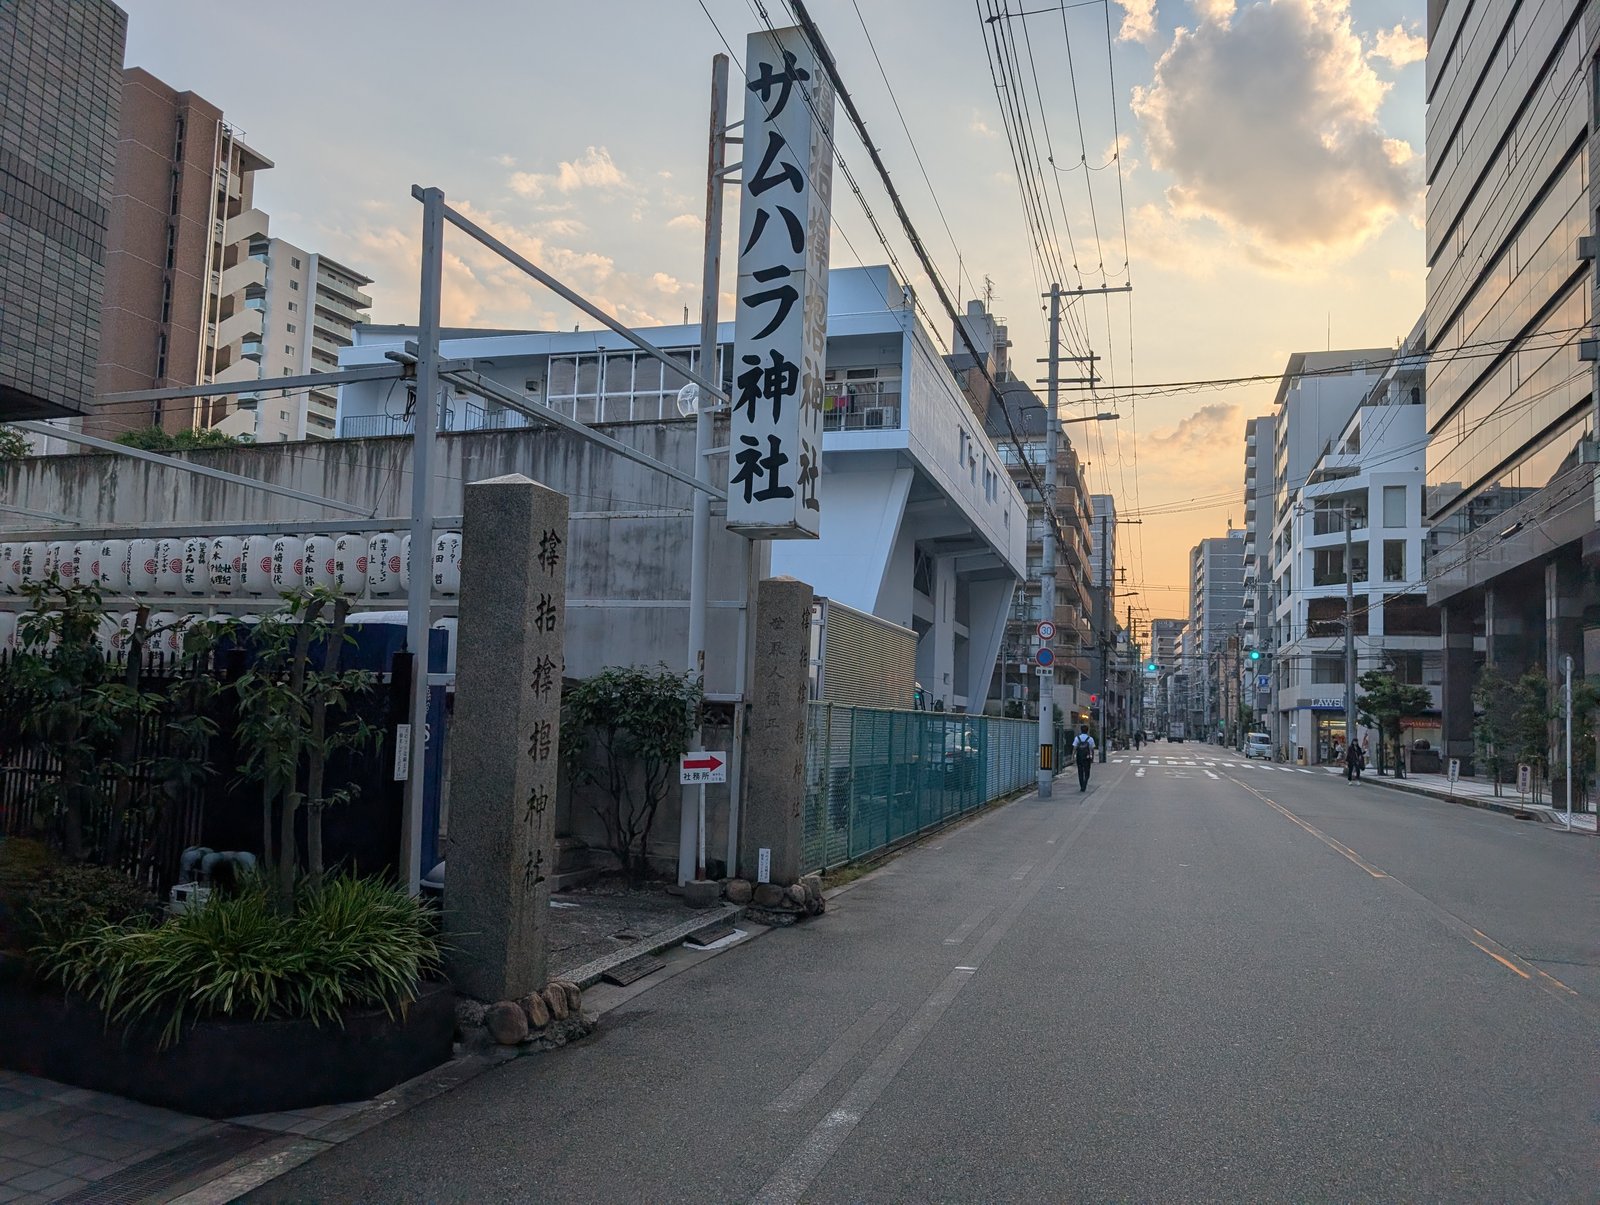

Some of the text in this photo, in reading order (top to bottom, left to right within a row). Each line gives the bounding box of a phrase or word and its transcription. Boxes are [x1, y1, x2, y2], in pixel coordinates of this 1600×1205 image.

[731, 50, 810, 505] サムハラ神社
[1041, 626, 1052, 635] 30
[1311, 698, 1344, 707] LAWS
[683, 771, 710, 781] 社務所
